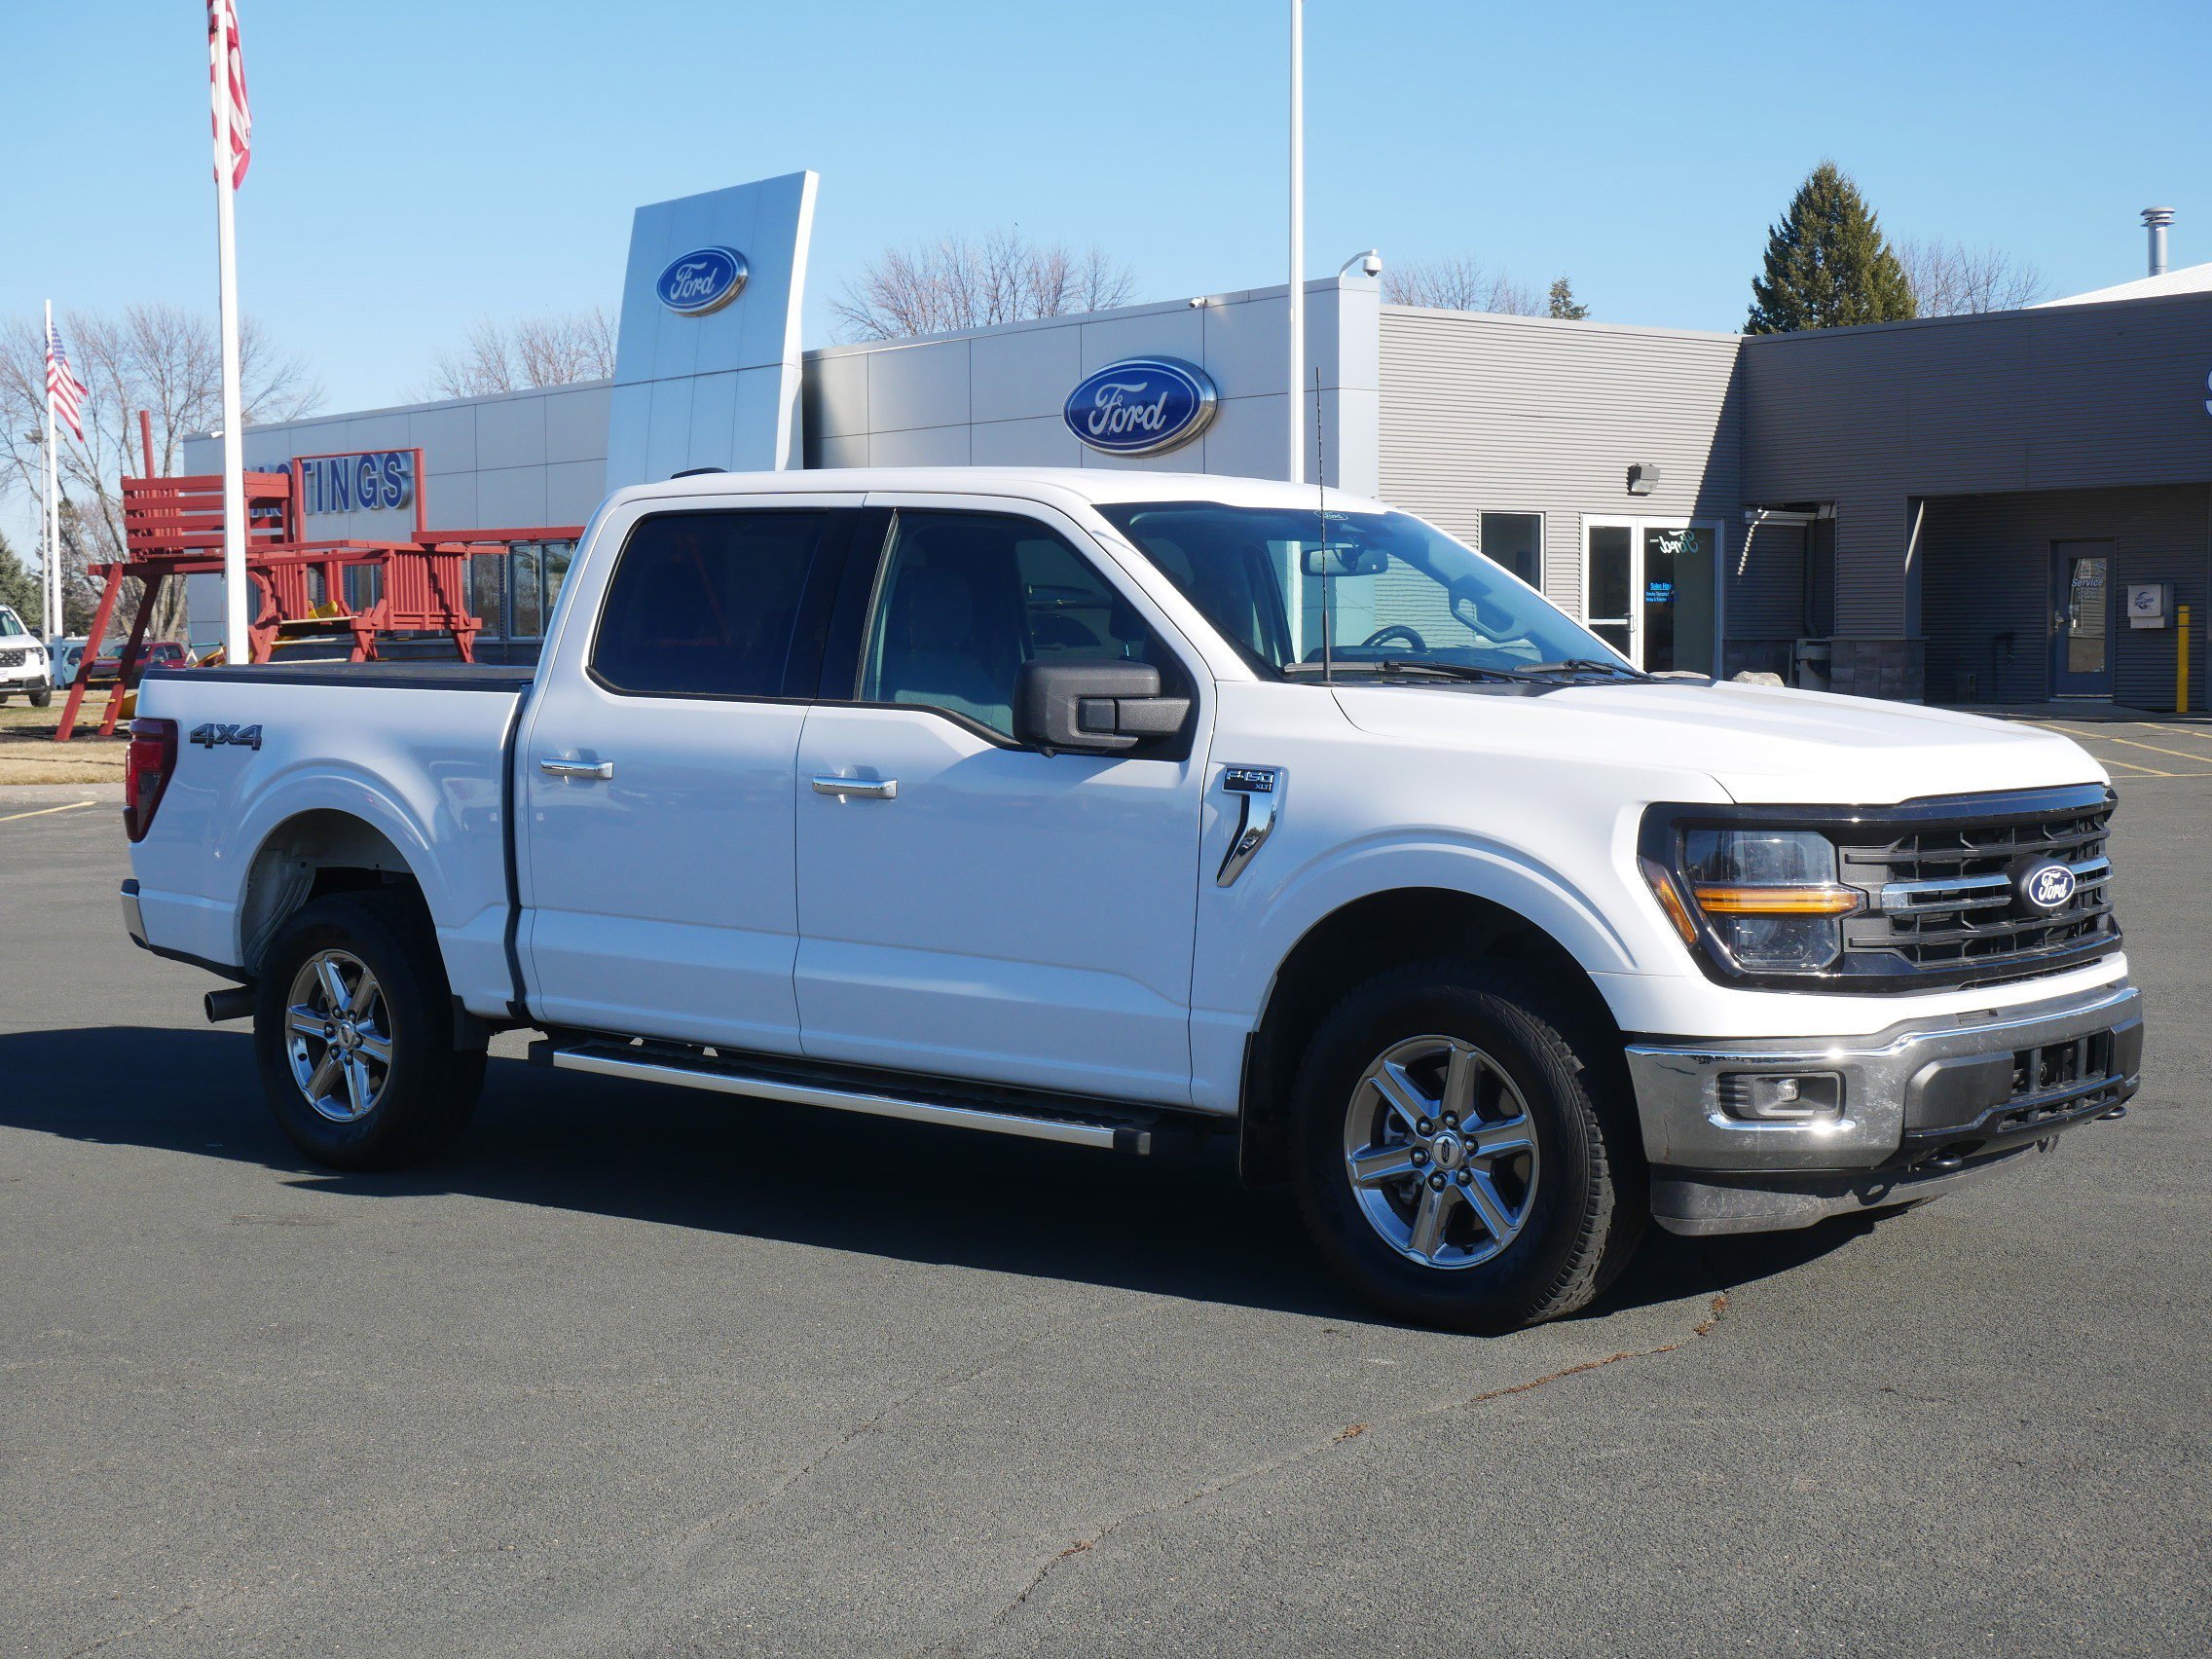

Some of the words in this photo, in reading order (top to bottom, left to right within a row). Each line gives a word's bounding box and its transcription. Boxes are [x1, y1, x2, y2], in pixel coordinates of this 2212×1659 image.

[670, 262, 718, 300] Ford
[1088, 382, 1168, 435] Ford
[2072, 578, 2103, 587] Service
[1227, 770, 1273, 783] F-150
[2039, 872, 2067, 901] Ford
